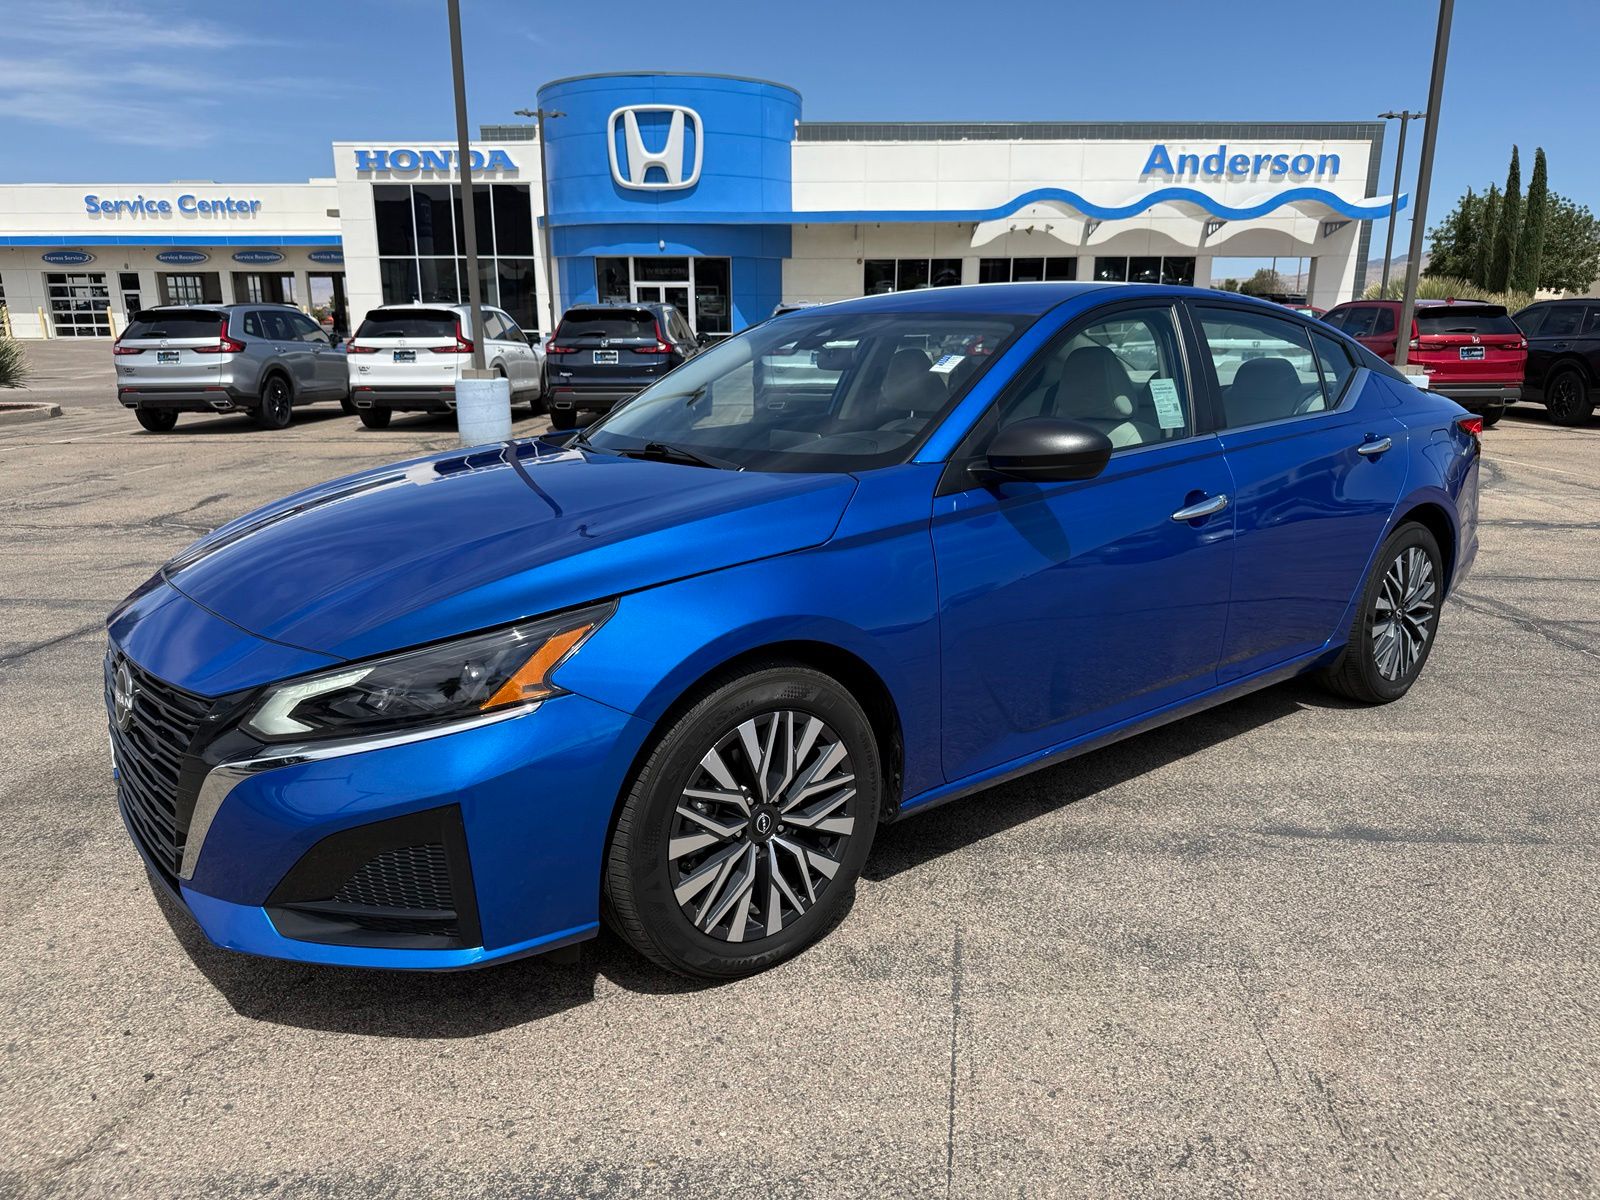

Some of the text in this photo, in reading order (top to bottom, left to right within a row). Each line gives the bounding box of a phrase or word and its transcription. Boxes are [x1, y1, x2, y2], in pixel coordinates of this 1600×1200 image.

[353, 149, 519, 172] HONDA
[1140, 144, 1341, 176] Anderson
[84, 194, 262, 214] Service Center
